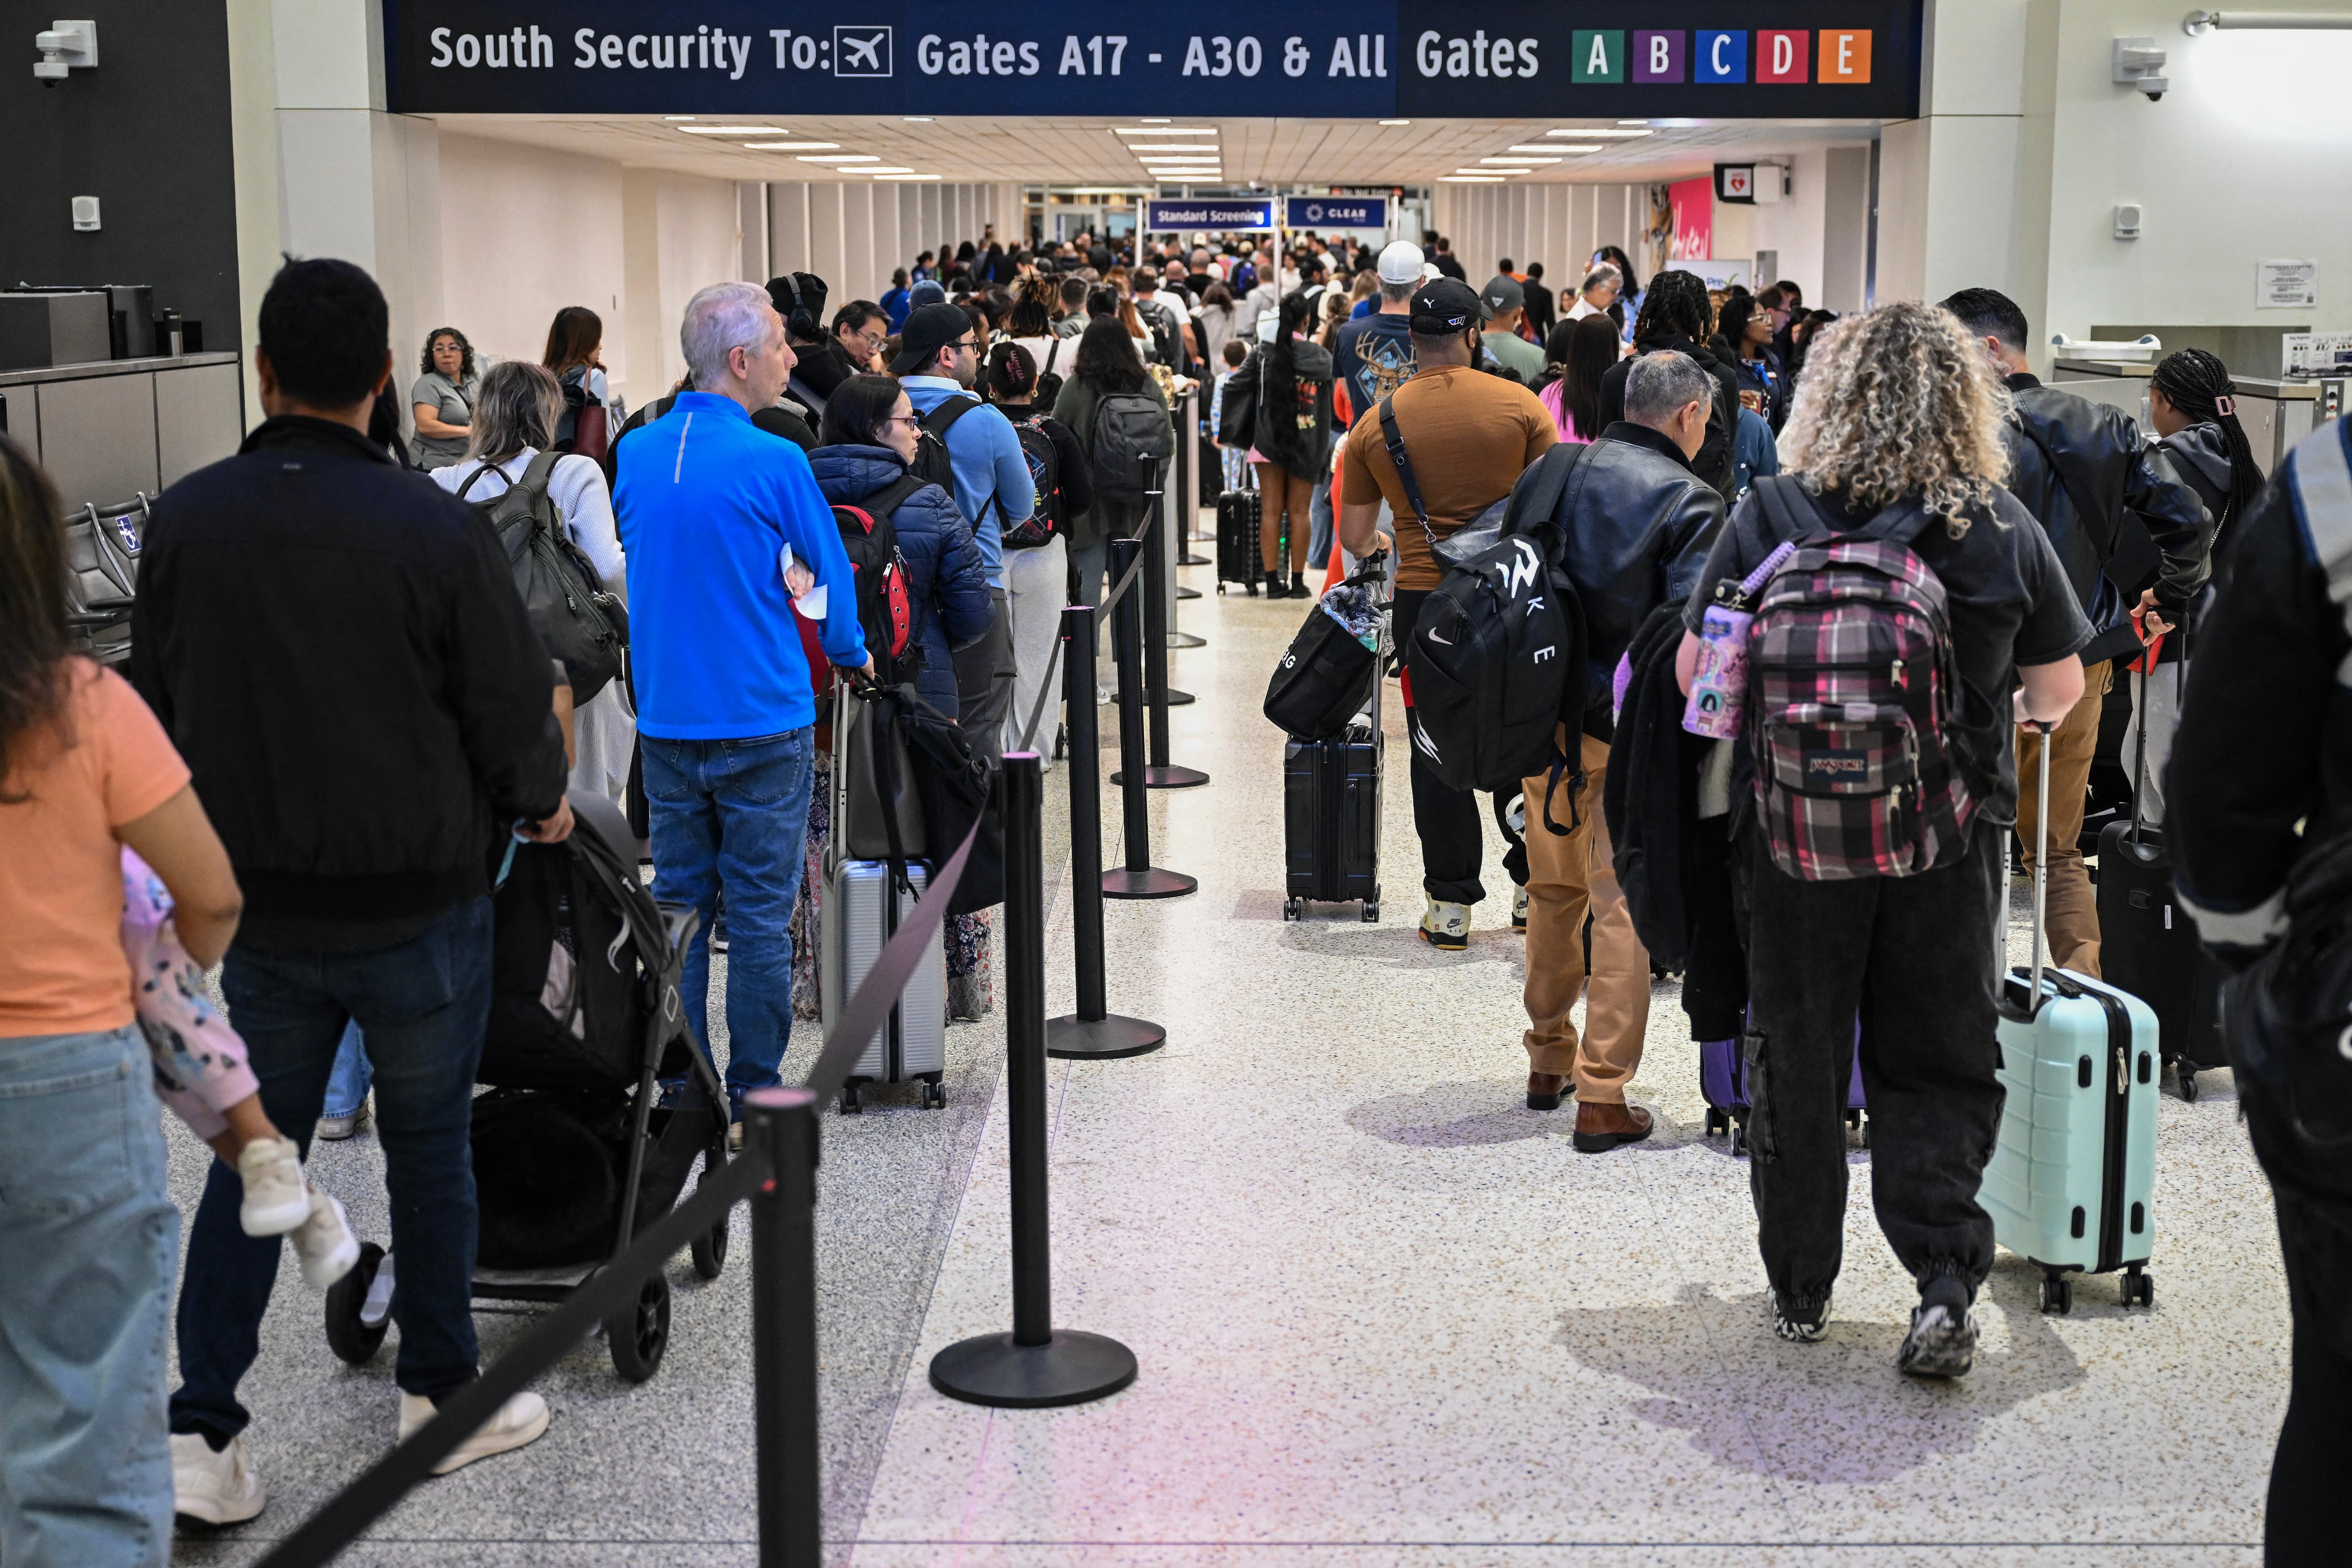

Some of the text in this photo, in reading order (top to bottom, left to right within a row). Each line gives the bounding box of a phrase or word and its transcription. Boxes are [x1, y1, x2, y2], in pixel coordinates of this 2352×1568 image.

[430, 25, 1854, 80] South Security To: Gates A17 - A30 & All Gates A B C D E
[1157, 209, 1264, 225] Standard Screening
[1328, 208, 1367, 218] CLEAR
